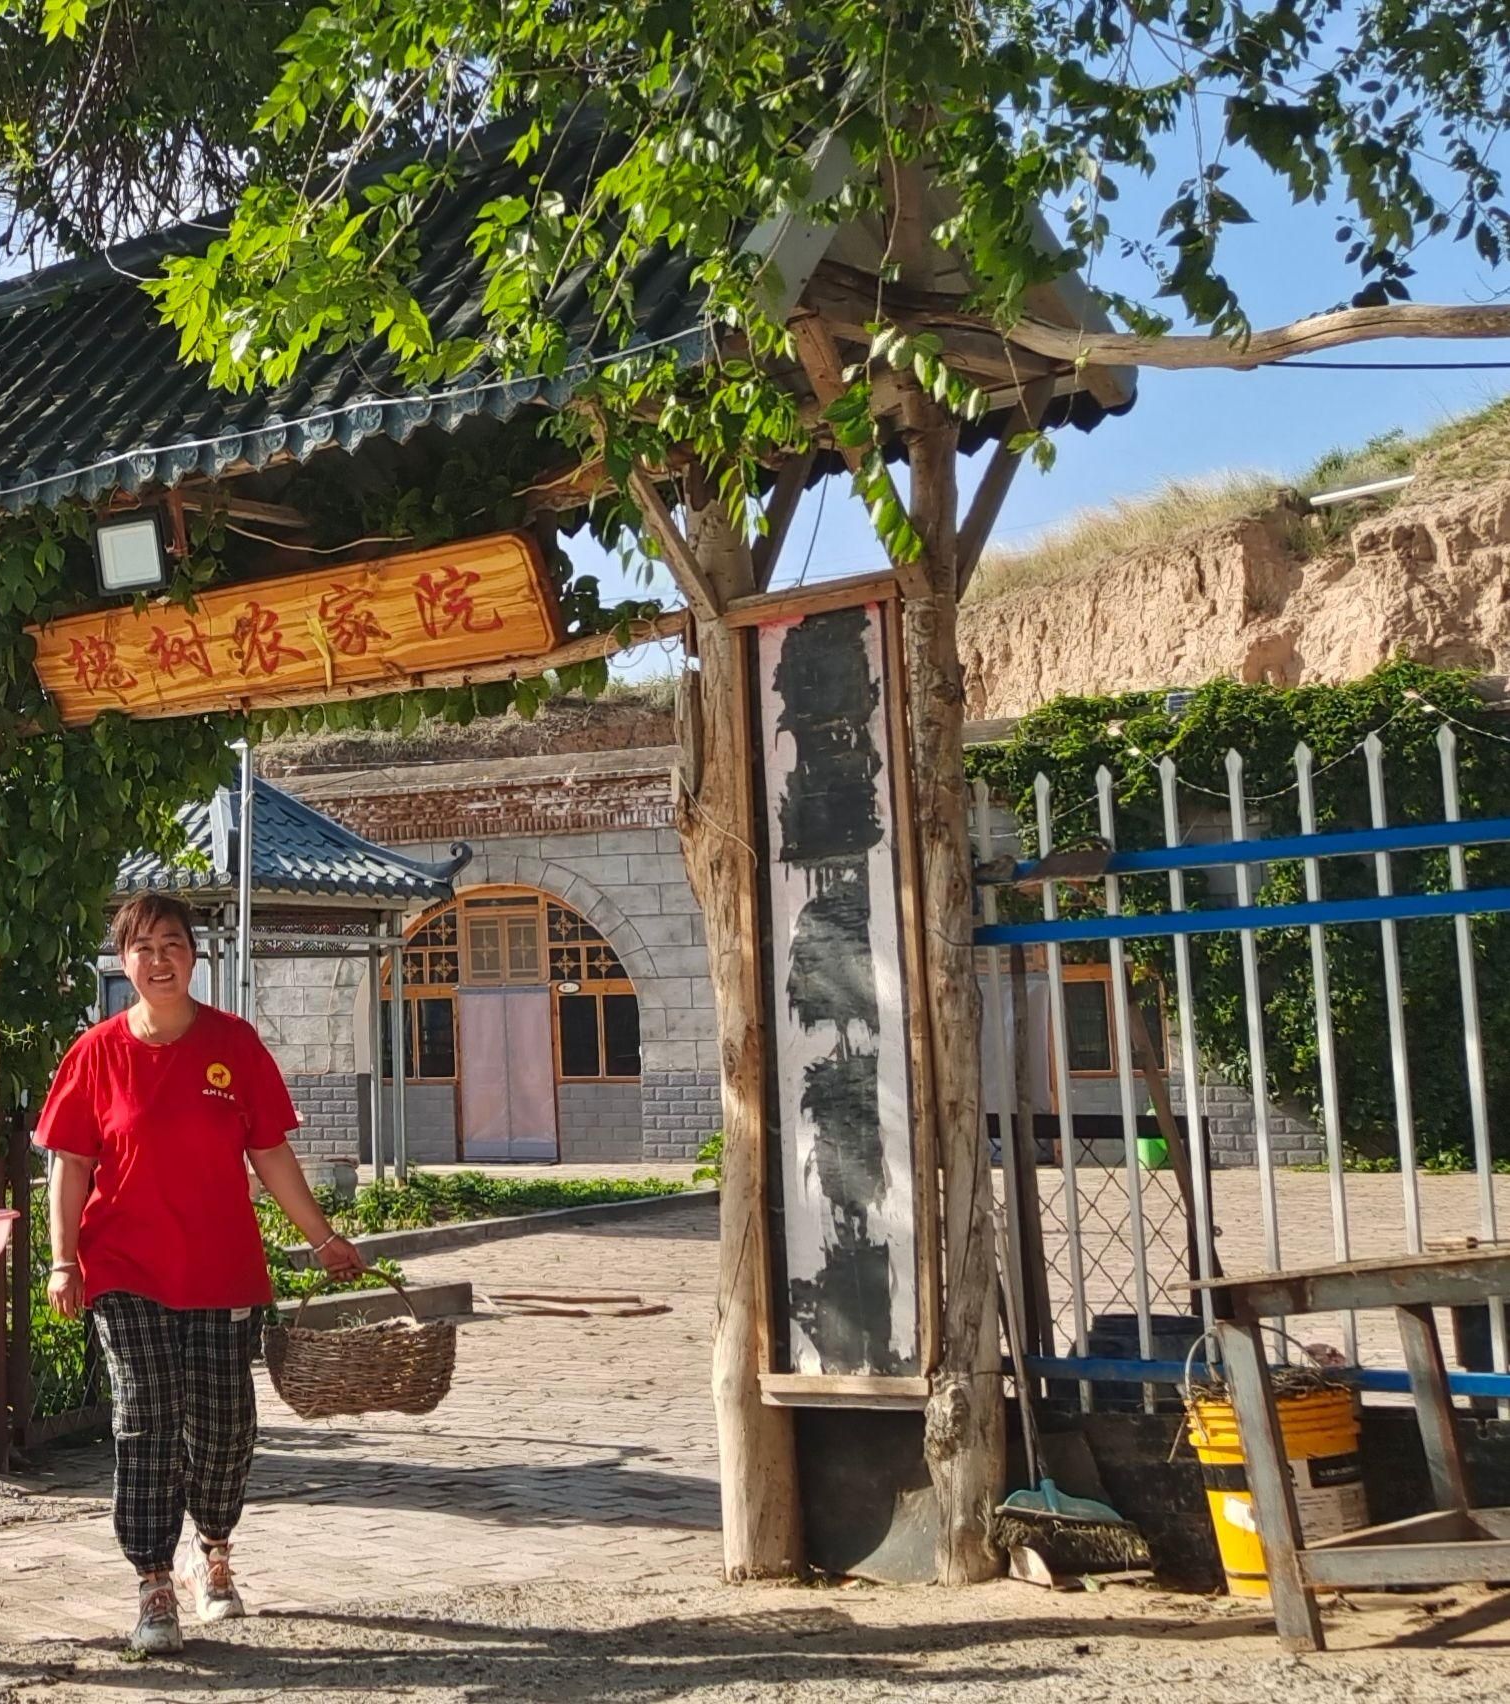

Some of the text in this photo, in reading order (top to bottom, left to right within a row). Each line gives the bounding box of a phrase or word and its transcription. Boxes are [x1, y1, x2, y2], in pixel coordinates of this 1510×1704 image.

[67, 565, 503, 691] 槐树农家院
